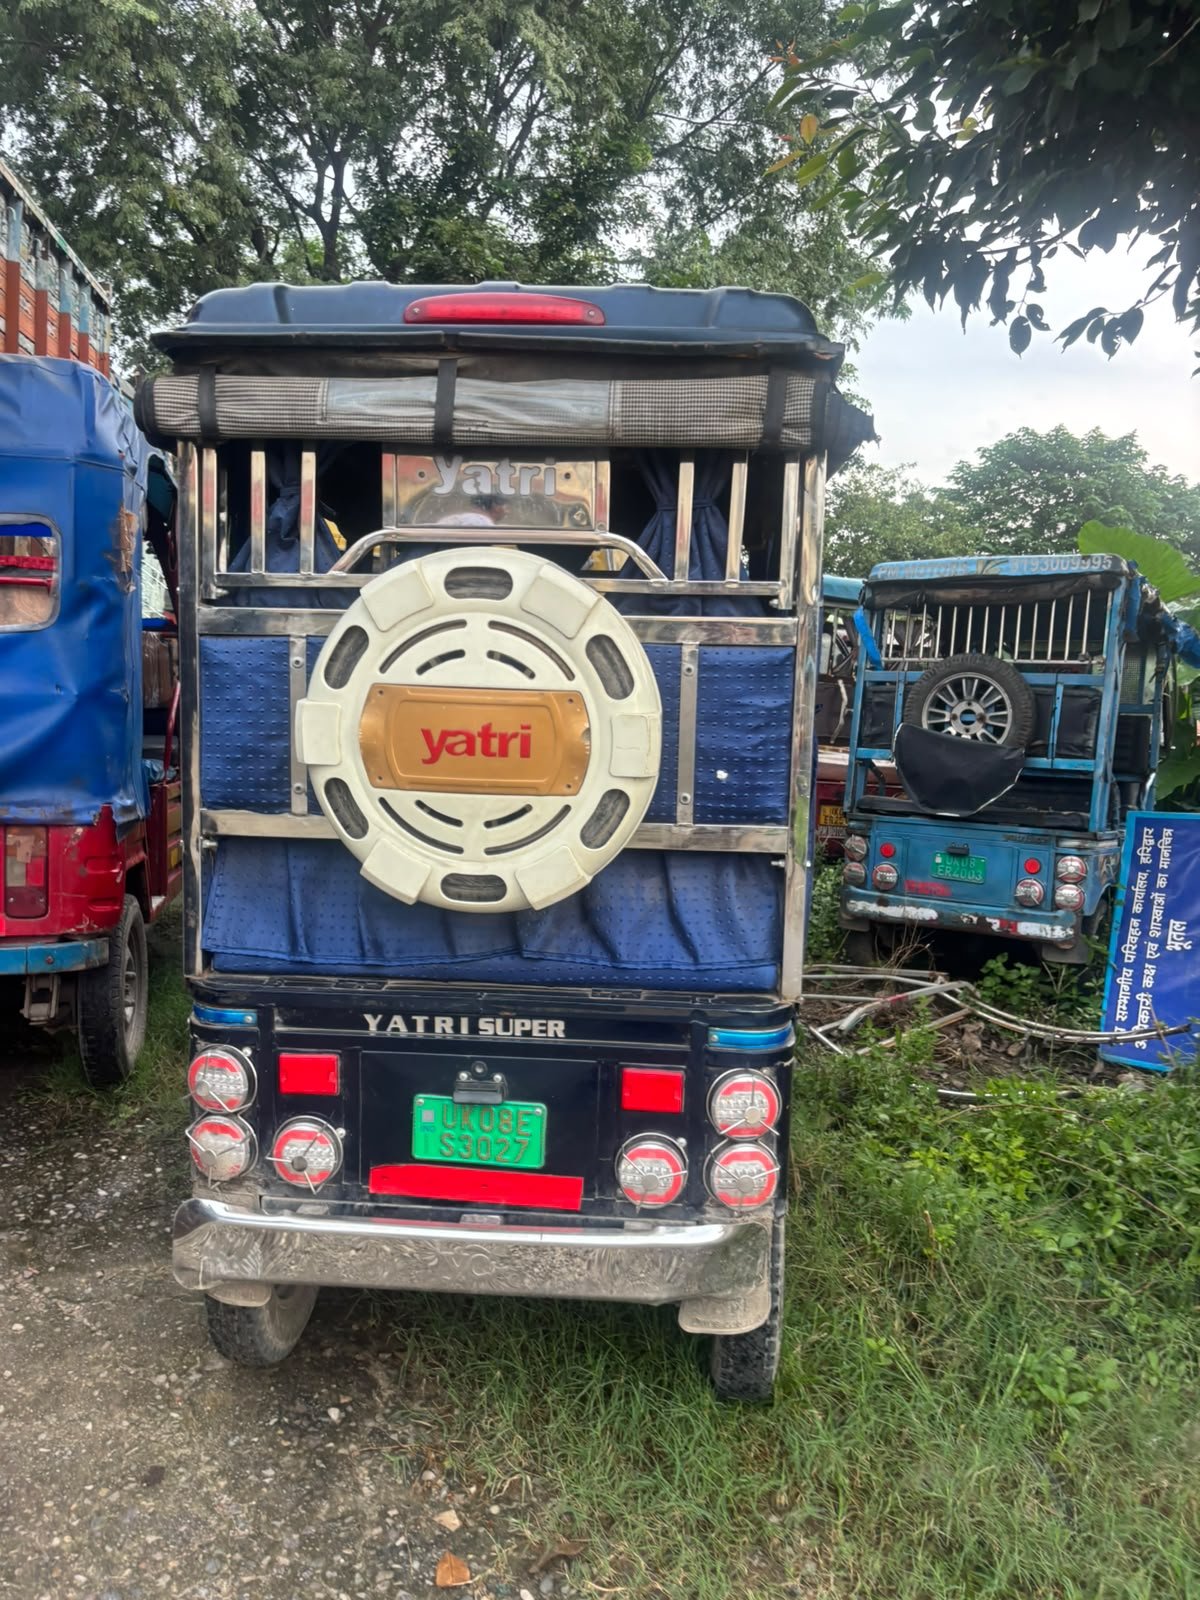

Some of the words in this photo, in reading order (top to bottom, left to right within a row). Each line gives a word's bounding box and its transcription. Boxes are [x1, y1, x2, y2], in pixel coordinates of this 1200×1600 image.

[433, 455, 557, 496] yatri
[420, 722, 532, 765] yatri
[1137, 827, 1155, 865] हरिद्वार
[1157, 827, 1174, 870] मानचित्र
[1156, 874, 1169, 888] का
[1149, 892, 1169, 938] शाखाओं
[1121, 918, 1142, 963] परिवहन
[1143, 941, 1161, 959] एवं
[1166, 919, 1191, 952] भूतल
[1142, 964, 1156, 988] कक्ष
[1116, 968, 1134, 1021] सम्भागीय
[363, 1013, 470, 1034] YATRI
[479, 1017, 566, 1038] SUPER
[442, 1104, 532, 1137] UK08E
[440, 1132, 529, 1163] S3027
